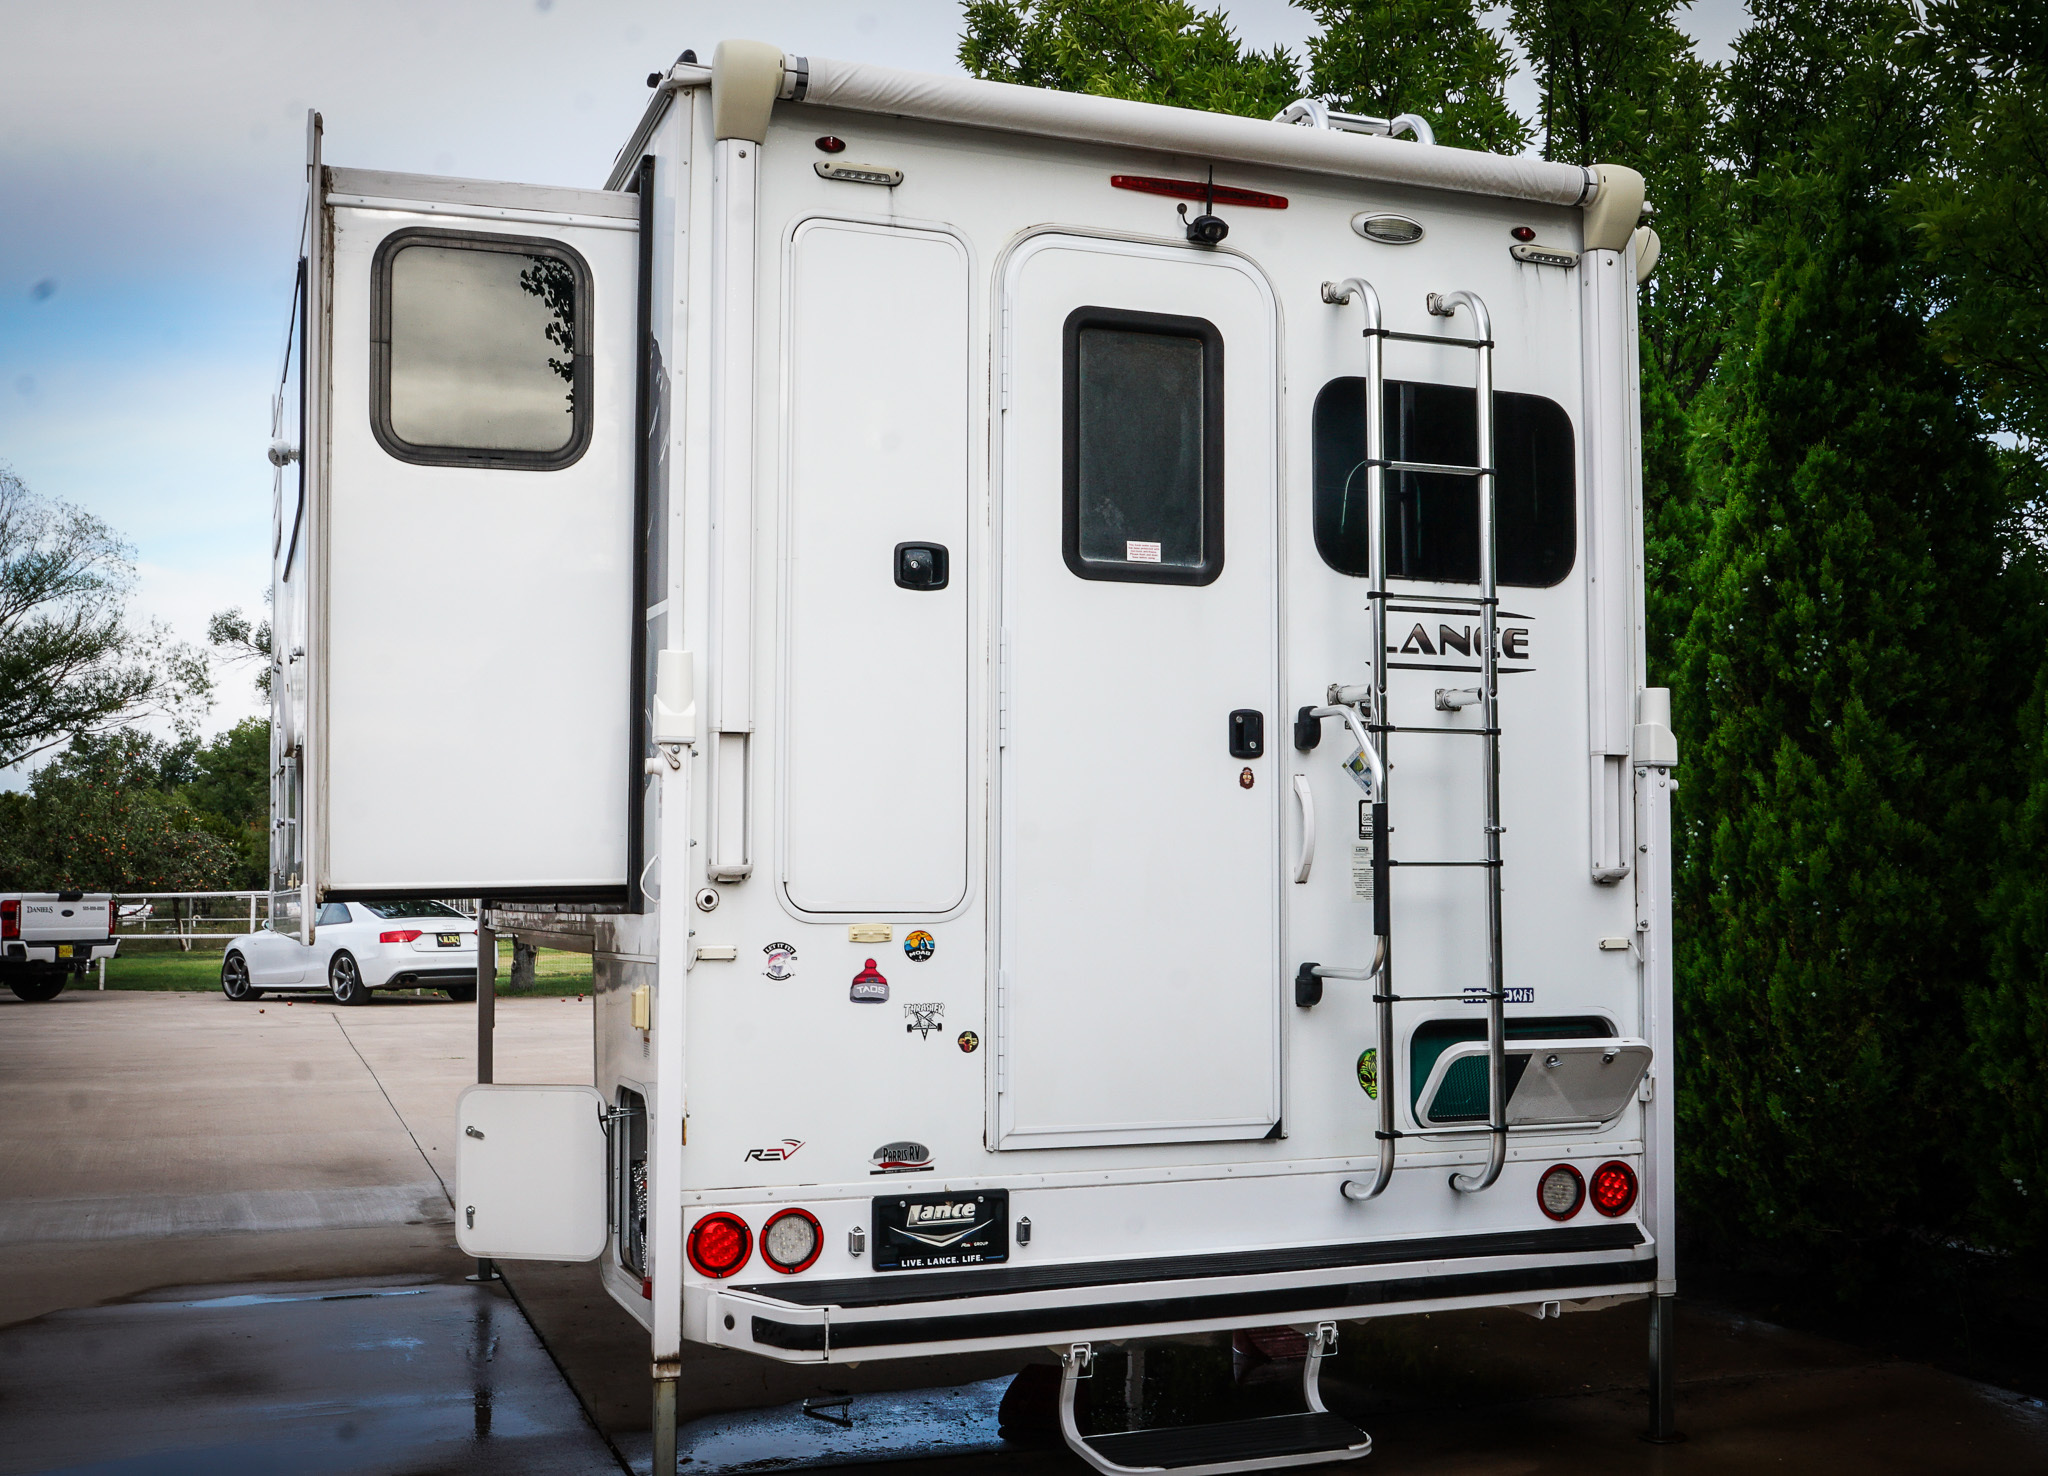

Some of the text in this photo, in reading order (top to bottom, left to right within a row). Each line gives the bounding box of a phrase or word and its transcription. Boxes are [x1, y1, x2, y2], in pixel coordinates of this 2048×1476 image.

[1386, 622, 1530, 660] ANE
[26, 905, 53, 914] DANIELS
[856, 985, 886, 995] TAOS
[904, 1003, 945, 1018] THRASHER
[883, 1145, 921, 1162] PARRIS RV
[901, 1254, 984, 1267] LIVE. LANCE. LIFE.
